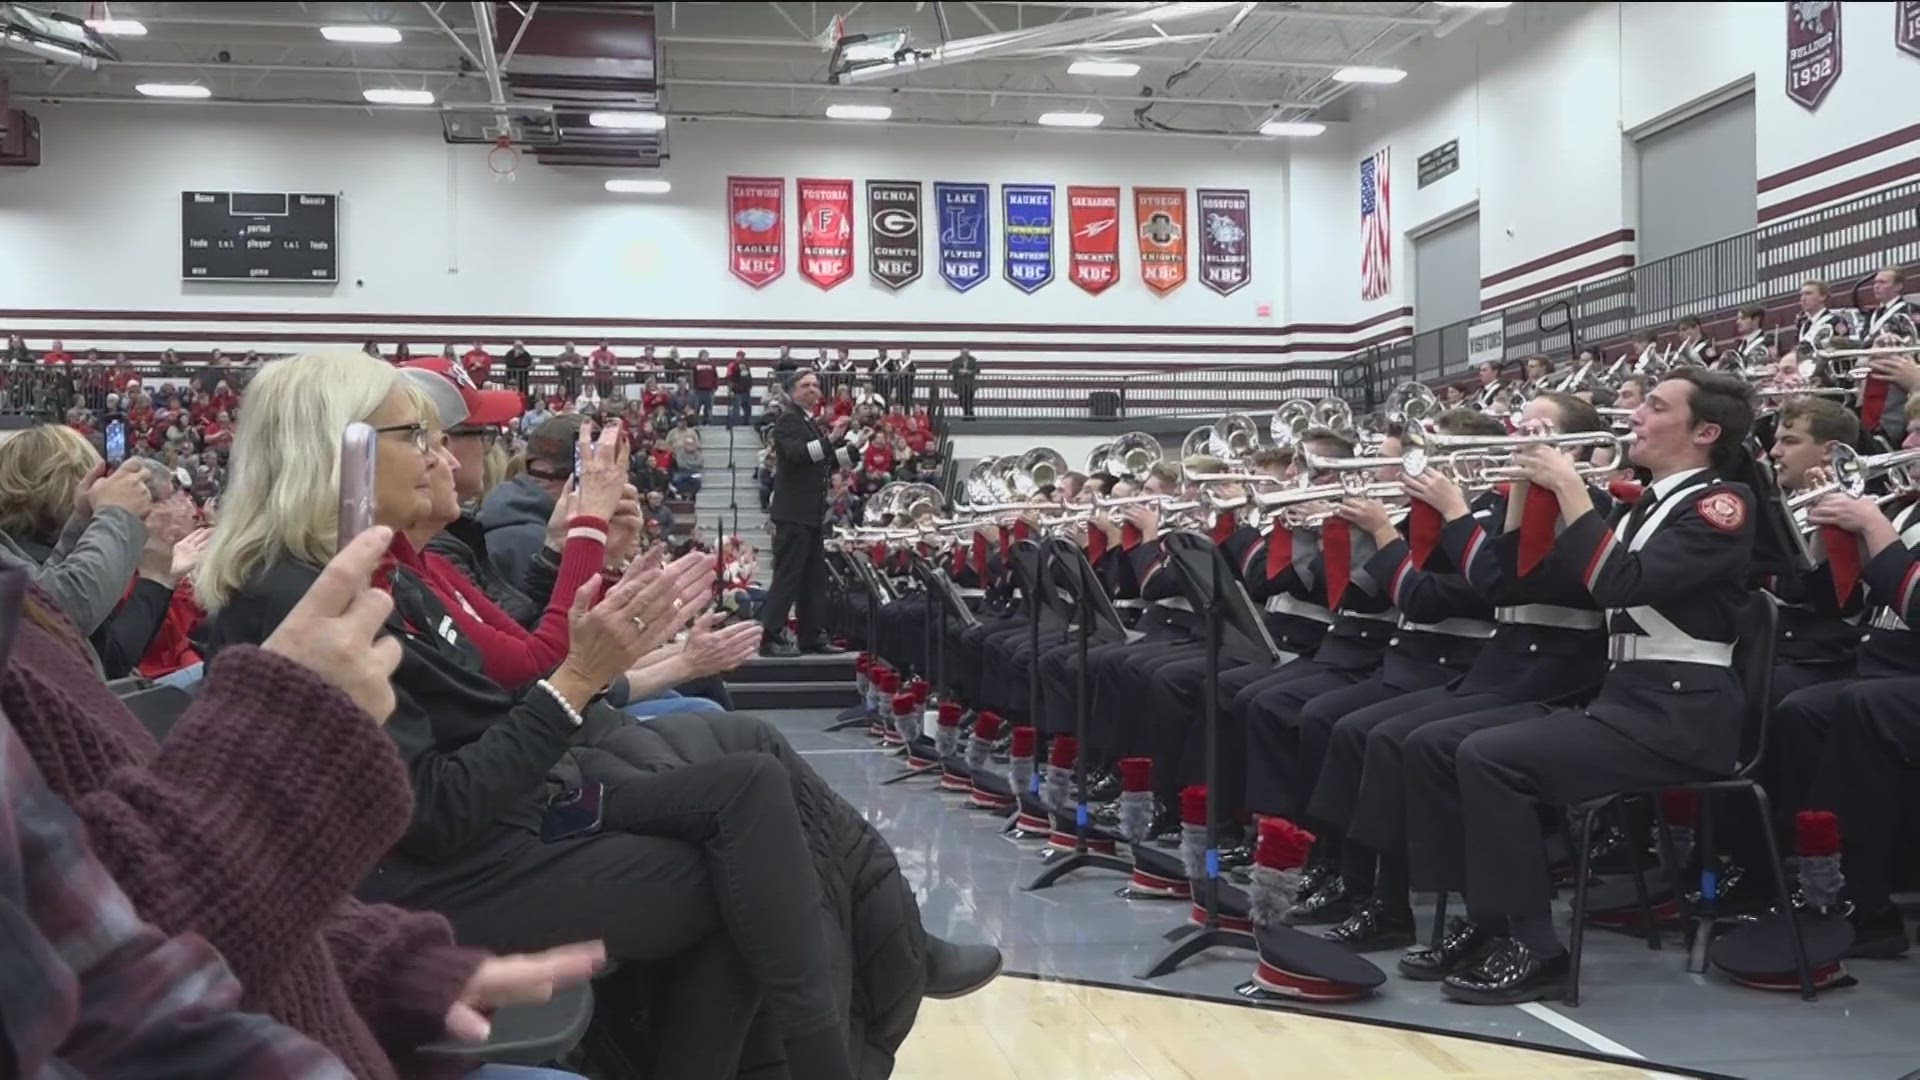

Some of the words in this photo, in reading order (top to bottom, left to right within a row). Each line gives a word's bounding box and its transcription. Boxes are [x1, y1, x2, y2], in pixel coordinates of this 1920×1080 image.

[1793, 58, 1832, 89] 1932
[803, 190, 848, 200] FOSTORIA
[873, 191, 915, 201] GENOA
[946, 193, 977, 203] LAKE
[1010, 195, 1049, 205] MAUMEE
[1140, 196, 1180, 205] OTSEGO
[1203, 199, 1246, 209] ROSSFORD
[736, 245, 779, 253] EAGLES
[874, 247, 916, 256] COMETS
[944, 250, 982, 258] FLYERS
[739, 259, 775, 271] NBC
[808, 260, 843, 274] NBC
[877, 261, 912, 274] NBC
[946, 263, 979, 276] NBC
[1012, 265, 1046, 278] NBC
[1078, 266, 1111, 280] NBC
[1145, 266, 1178, 279] NBC
[1209, 268, 1241, 280] NBC
[1471, 331, 1501, 354] VISITORS
